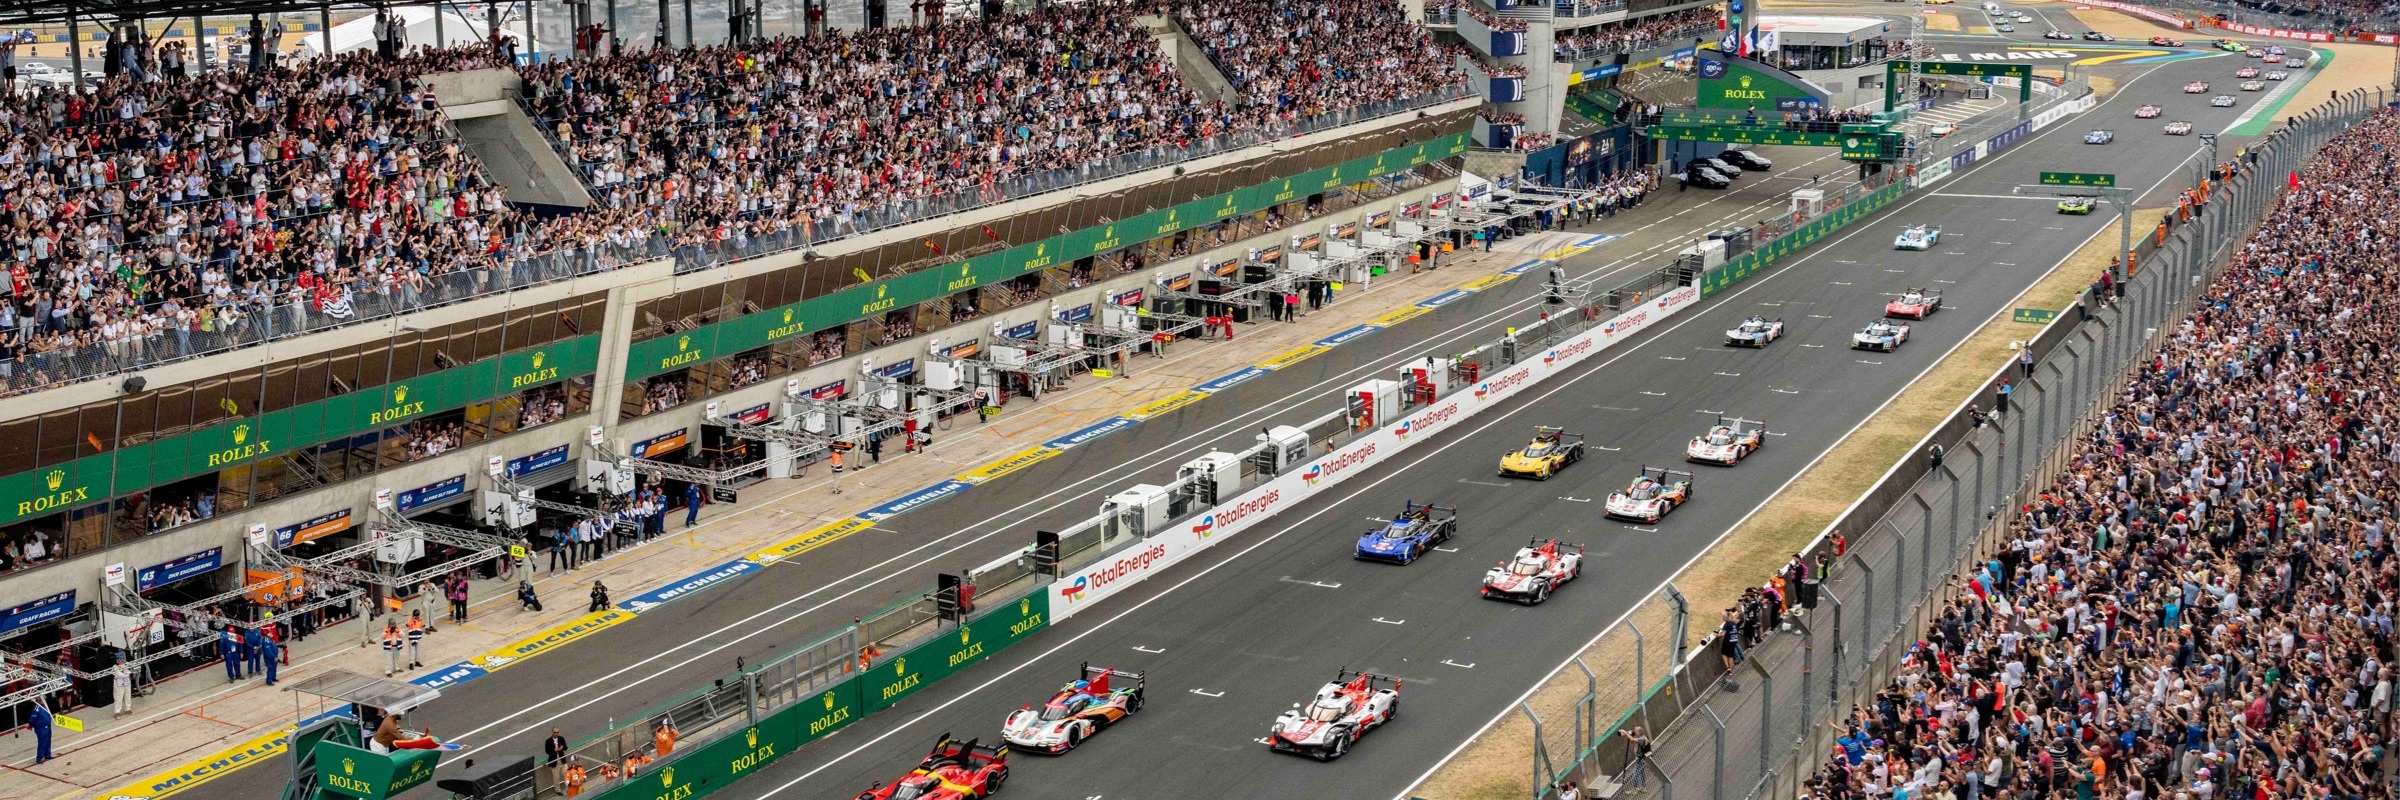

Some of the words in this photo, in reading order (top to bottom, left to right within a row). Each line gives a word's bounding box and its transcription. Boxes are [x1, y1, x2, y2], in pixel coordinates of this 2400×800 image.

[2274, 30, 2288, 38] MOTUL
[2291, 32, 2307, 40] MOTUL
[2375, 35, 2394, 43] MOTUL
[1970, 50, 2077, 61] MANS
[1724, 89, 1765, 99] ROLEX
[1324, 178, 1342, 189] ROLEX
[1276, 190, 1294, 202] ROLEX
[1216, 206, 1237, 218] ROLEX
[1158, 221, 1180, 234] ROLEX
[1094, 237, 1120, 251] ROLEX
[1025, 255, 1050, 270] ROLEX
[948, 276, 976, 291] ROLEX
[1704, 285, 1713, 294] ROLEX
[862, 298, 894, 314] ROLEX
[1668, 287, 1696, 307] TotalEnergies
[768, 322, 804, 340] ROLEX
[1614, 310, 1647, 333] TotalEnergies
[662, 350, 700, 368] ROLEX
[1556, 338, 1592, 362] TotalEnergies
[512, 367, 558, 388] ROLEX
[1216, 368, 1263, 388] MICHELIN
[1488, 367, 1530, 396] TotalEnergies
[976, 391, 985, 399] 45
[1147, 392, 1198, 413] MICHELIN
[370, 401, 424, 425] ROLEX
[1411, 402, 1458, 434] TotalEnergies
[1070, 419, 1128, 443] MICHELIN
[208, 440, 270, 467] ROLEX
[636, 445, 644, 454] 86
[986, 448, 1049, 475] MICHELIN
[1322, 442, 1376, 478] TotalEnergies
[617, 470, 631, 483] 35
[18, 486, 88, 516] ROLEX
[402, 495, 412, 504] 36
[888, 483, 962, 512] MICHELIN
[1215, 488, 1280, 530] TotalEnergies
[280, 530, 292, 540] 66
[782, 519, 862, 552] MICHELIN
[514, 548, 522, 556] 66
[141, 570, 155, 582] 43
[1088, 542, 1165, 591] TotalEnergies
[293, 586, 302, 595] 43
[658, 563, 750, 599] MICHELIN
[264, 592, 272, 601] 43
[516, 612, 619, 654] MICHELIN
[1010, 613, 1042, 638] ROLEX
[950, 642, 982, 668] ROLEX
[882, 673, 920, 700] ROLEX
[57, 716, 66, 726] 98
[810, 706, 849, 735] ROLEX
[732, 743, 774, 774] ROLEX
[328, 774, 372, 794] ROLEX
[390, 768, 433, 792] ROLEX
[655, 782, 692, 800] OLEX
